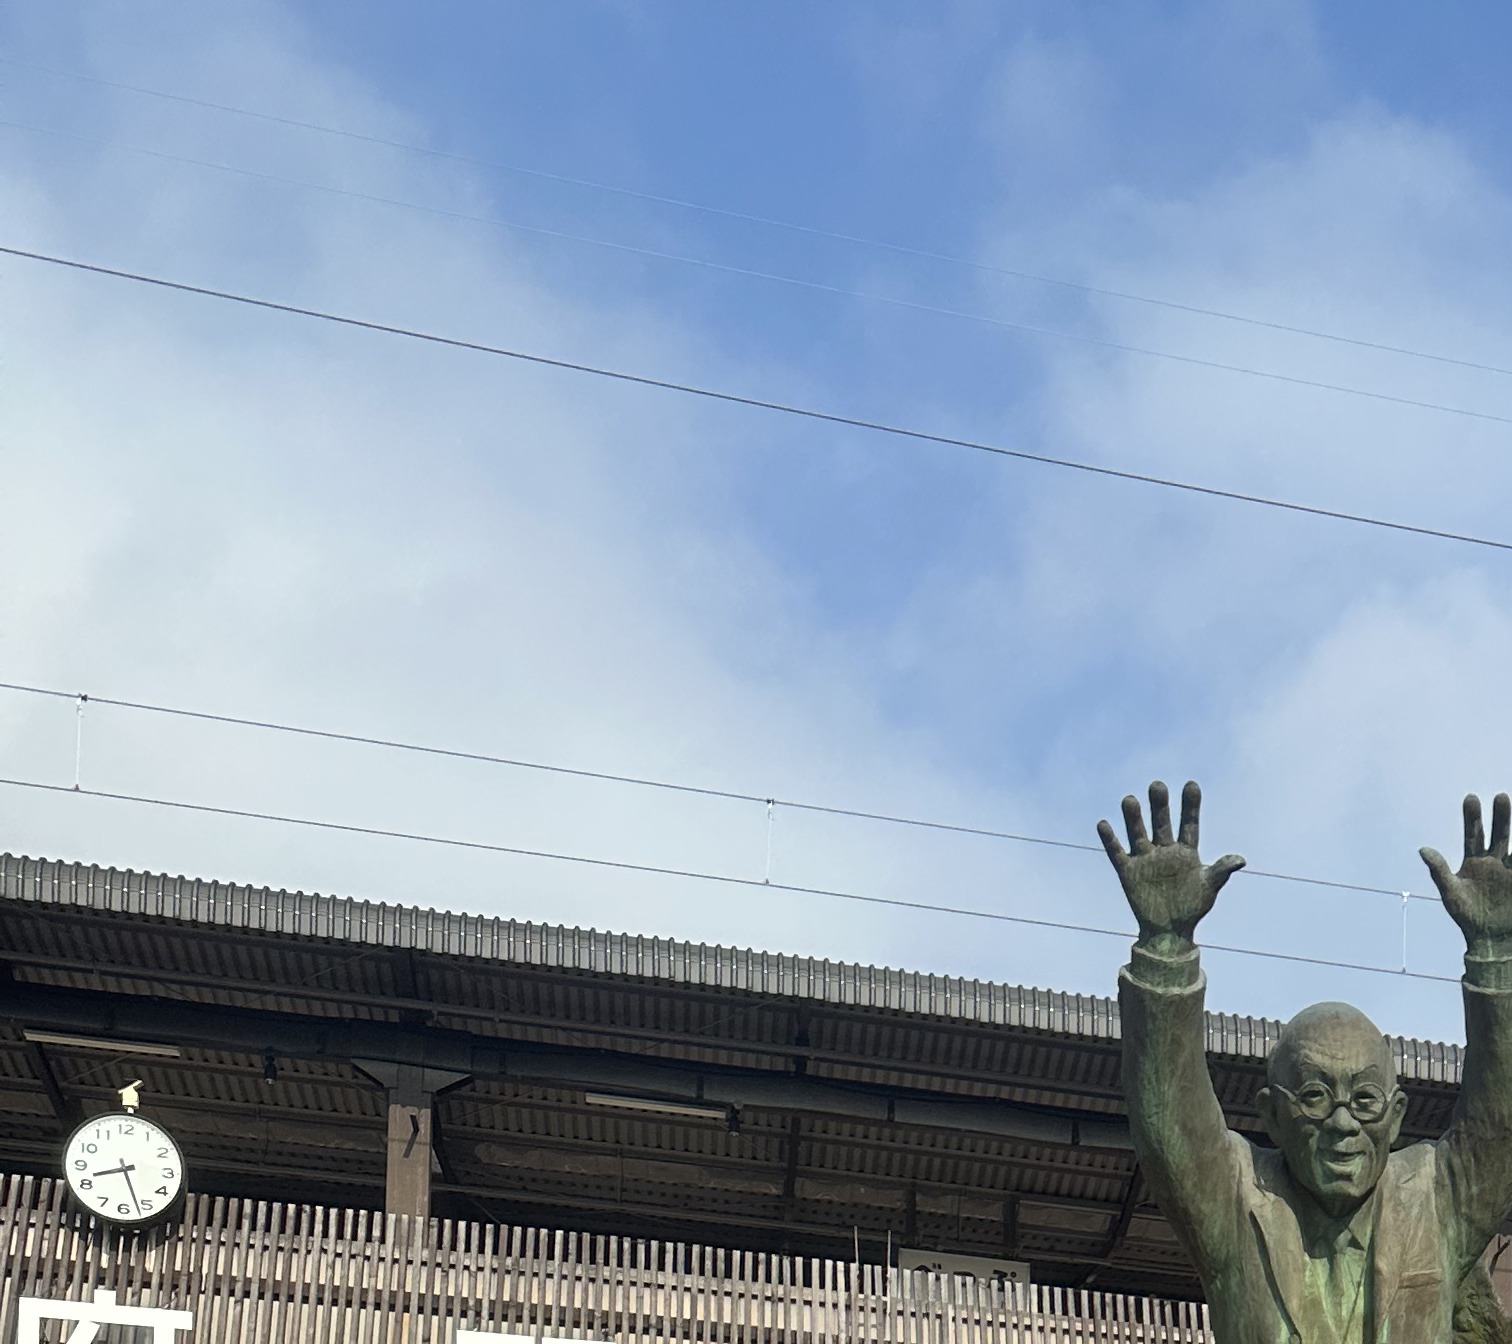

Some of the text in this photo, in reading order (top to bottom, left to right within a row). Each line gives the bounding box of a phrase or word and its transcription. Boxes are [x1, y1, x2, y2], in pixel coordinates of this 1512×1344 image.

[96, 1129, 110, 1140] 11
[119, 1124, 134, 1135] 12
[145, 1132, 149, 1142] 1
[82, 1143, 97, 1154] 10
[157, 1147, 168, 1158] 2
[75, 1160, 87, 1171] 9
[162, 1168, 174, 1178] 3
[80, 1179, 93, 1190] 8
[155, 1186, 168, 1196] 4
[97, 1197, 109, 1207] 7
[141, 1200, 153, 1210] 5
[118, 1204, 130, 1214] 6
